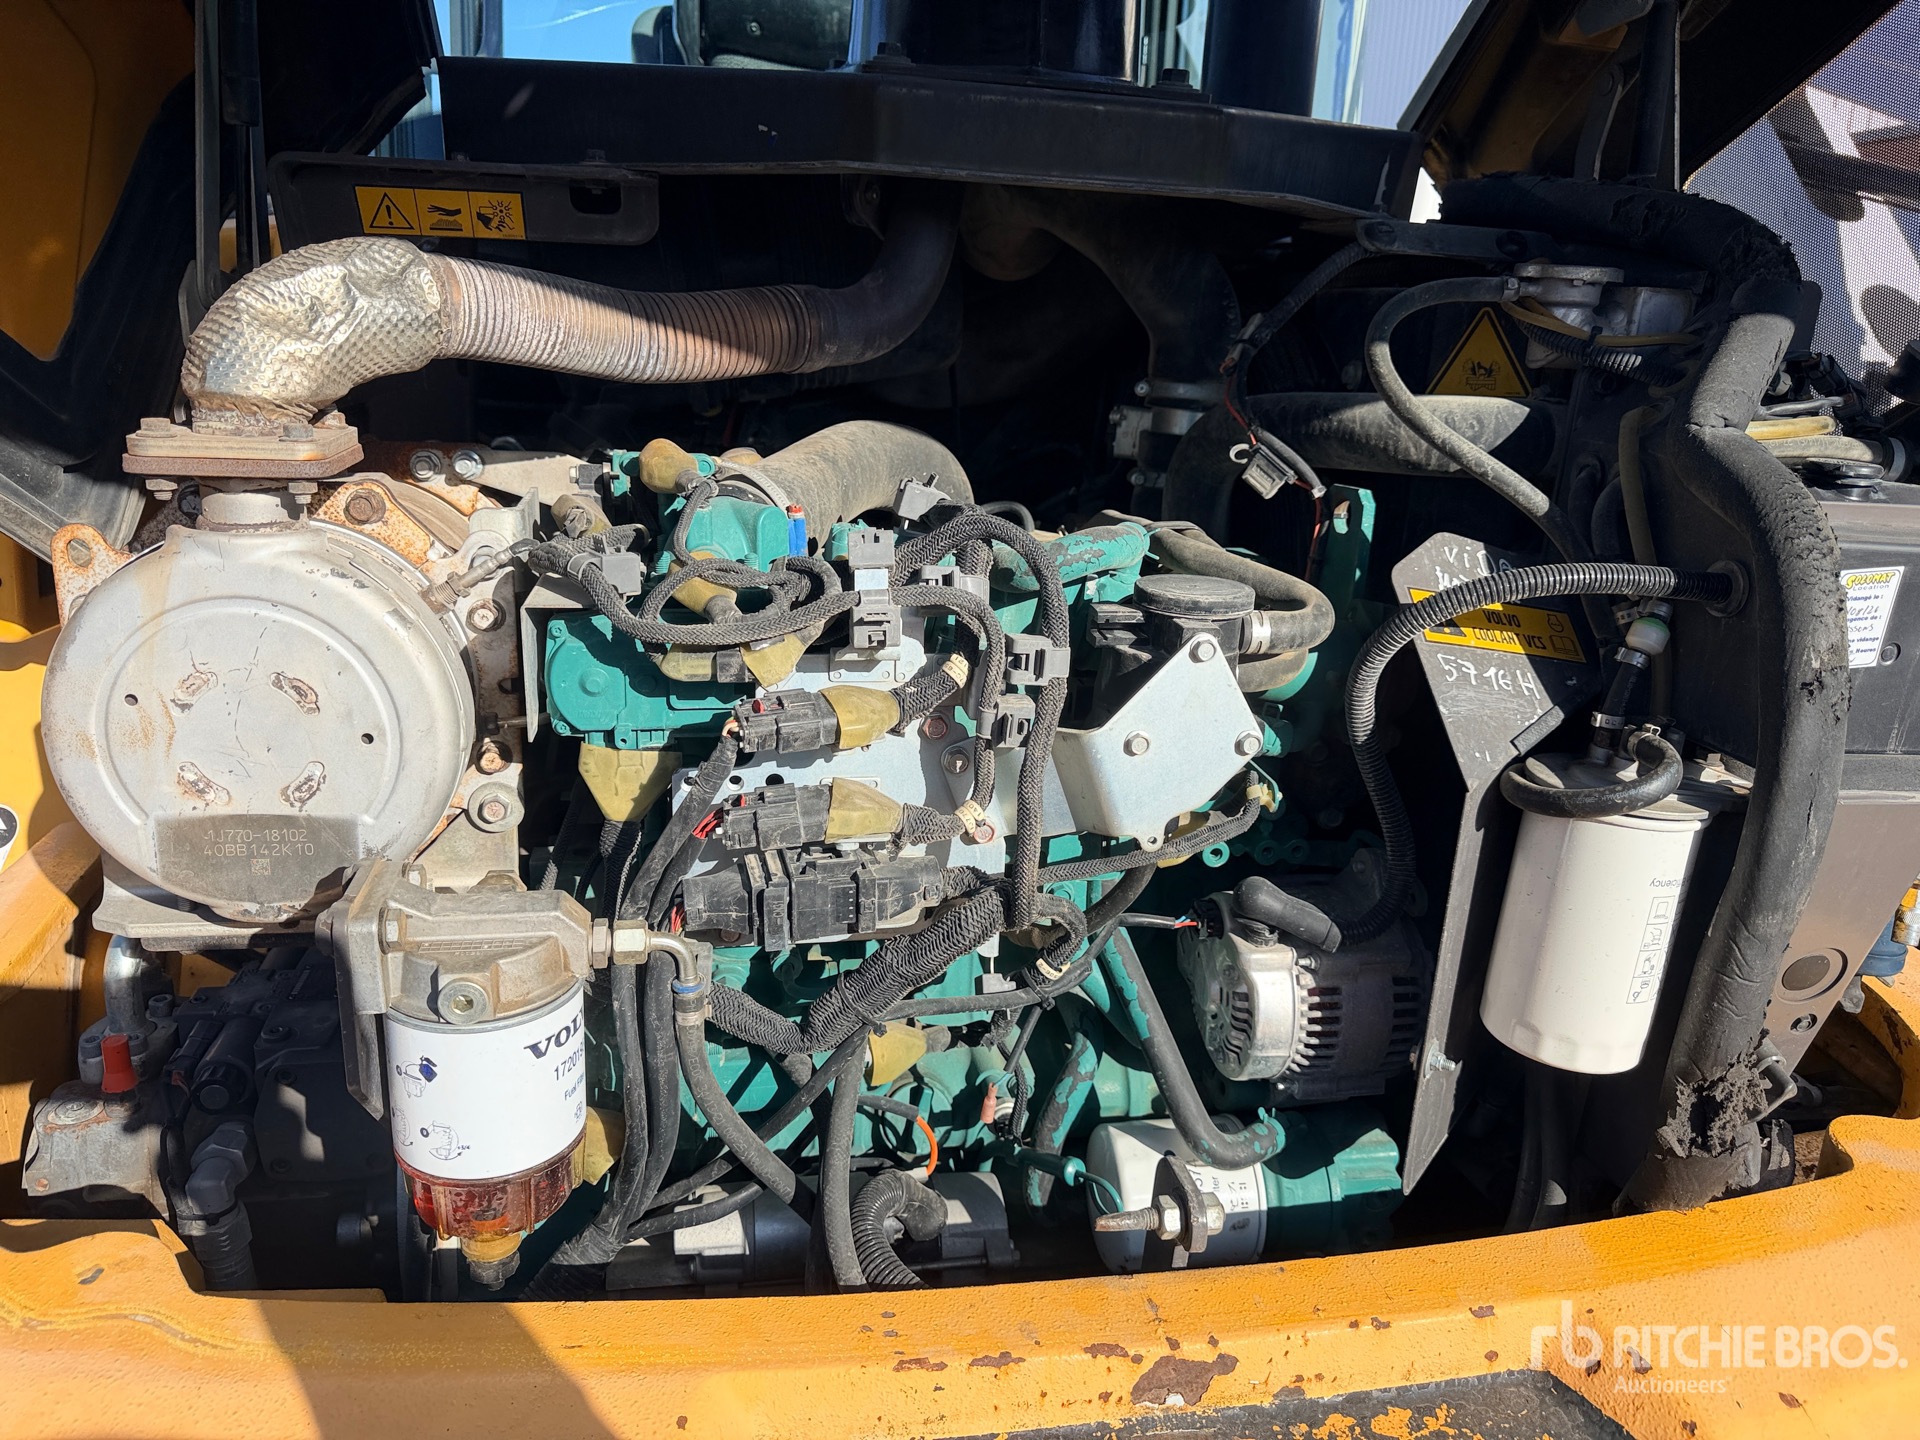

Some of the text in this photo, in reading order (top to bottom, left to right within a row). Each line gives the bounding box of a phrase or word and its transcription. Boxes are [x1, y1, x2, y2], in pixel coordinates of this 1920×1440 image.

[1852, 584, 1890, 592] Location
[1482, 609, 1522, 629] VOLVO
[1473, 626, 1547, 651] COOLANT VCS
[203, 843, 315, 857] 40BB142K10
